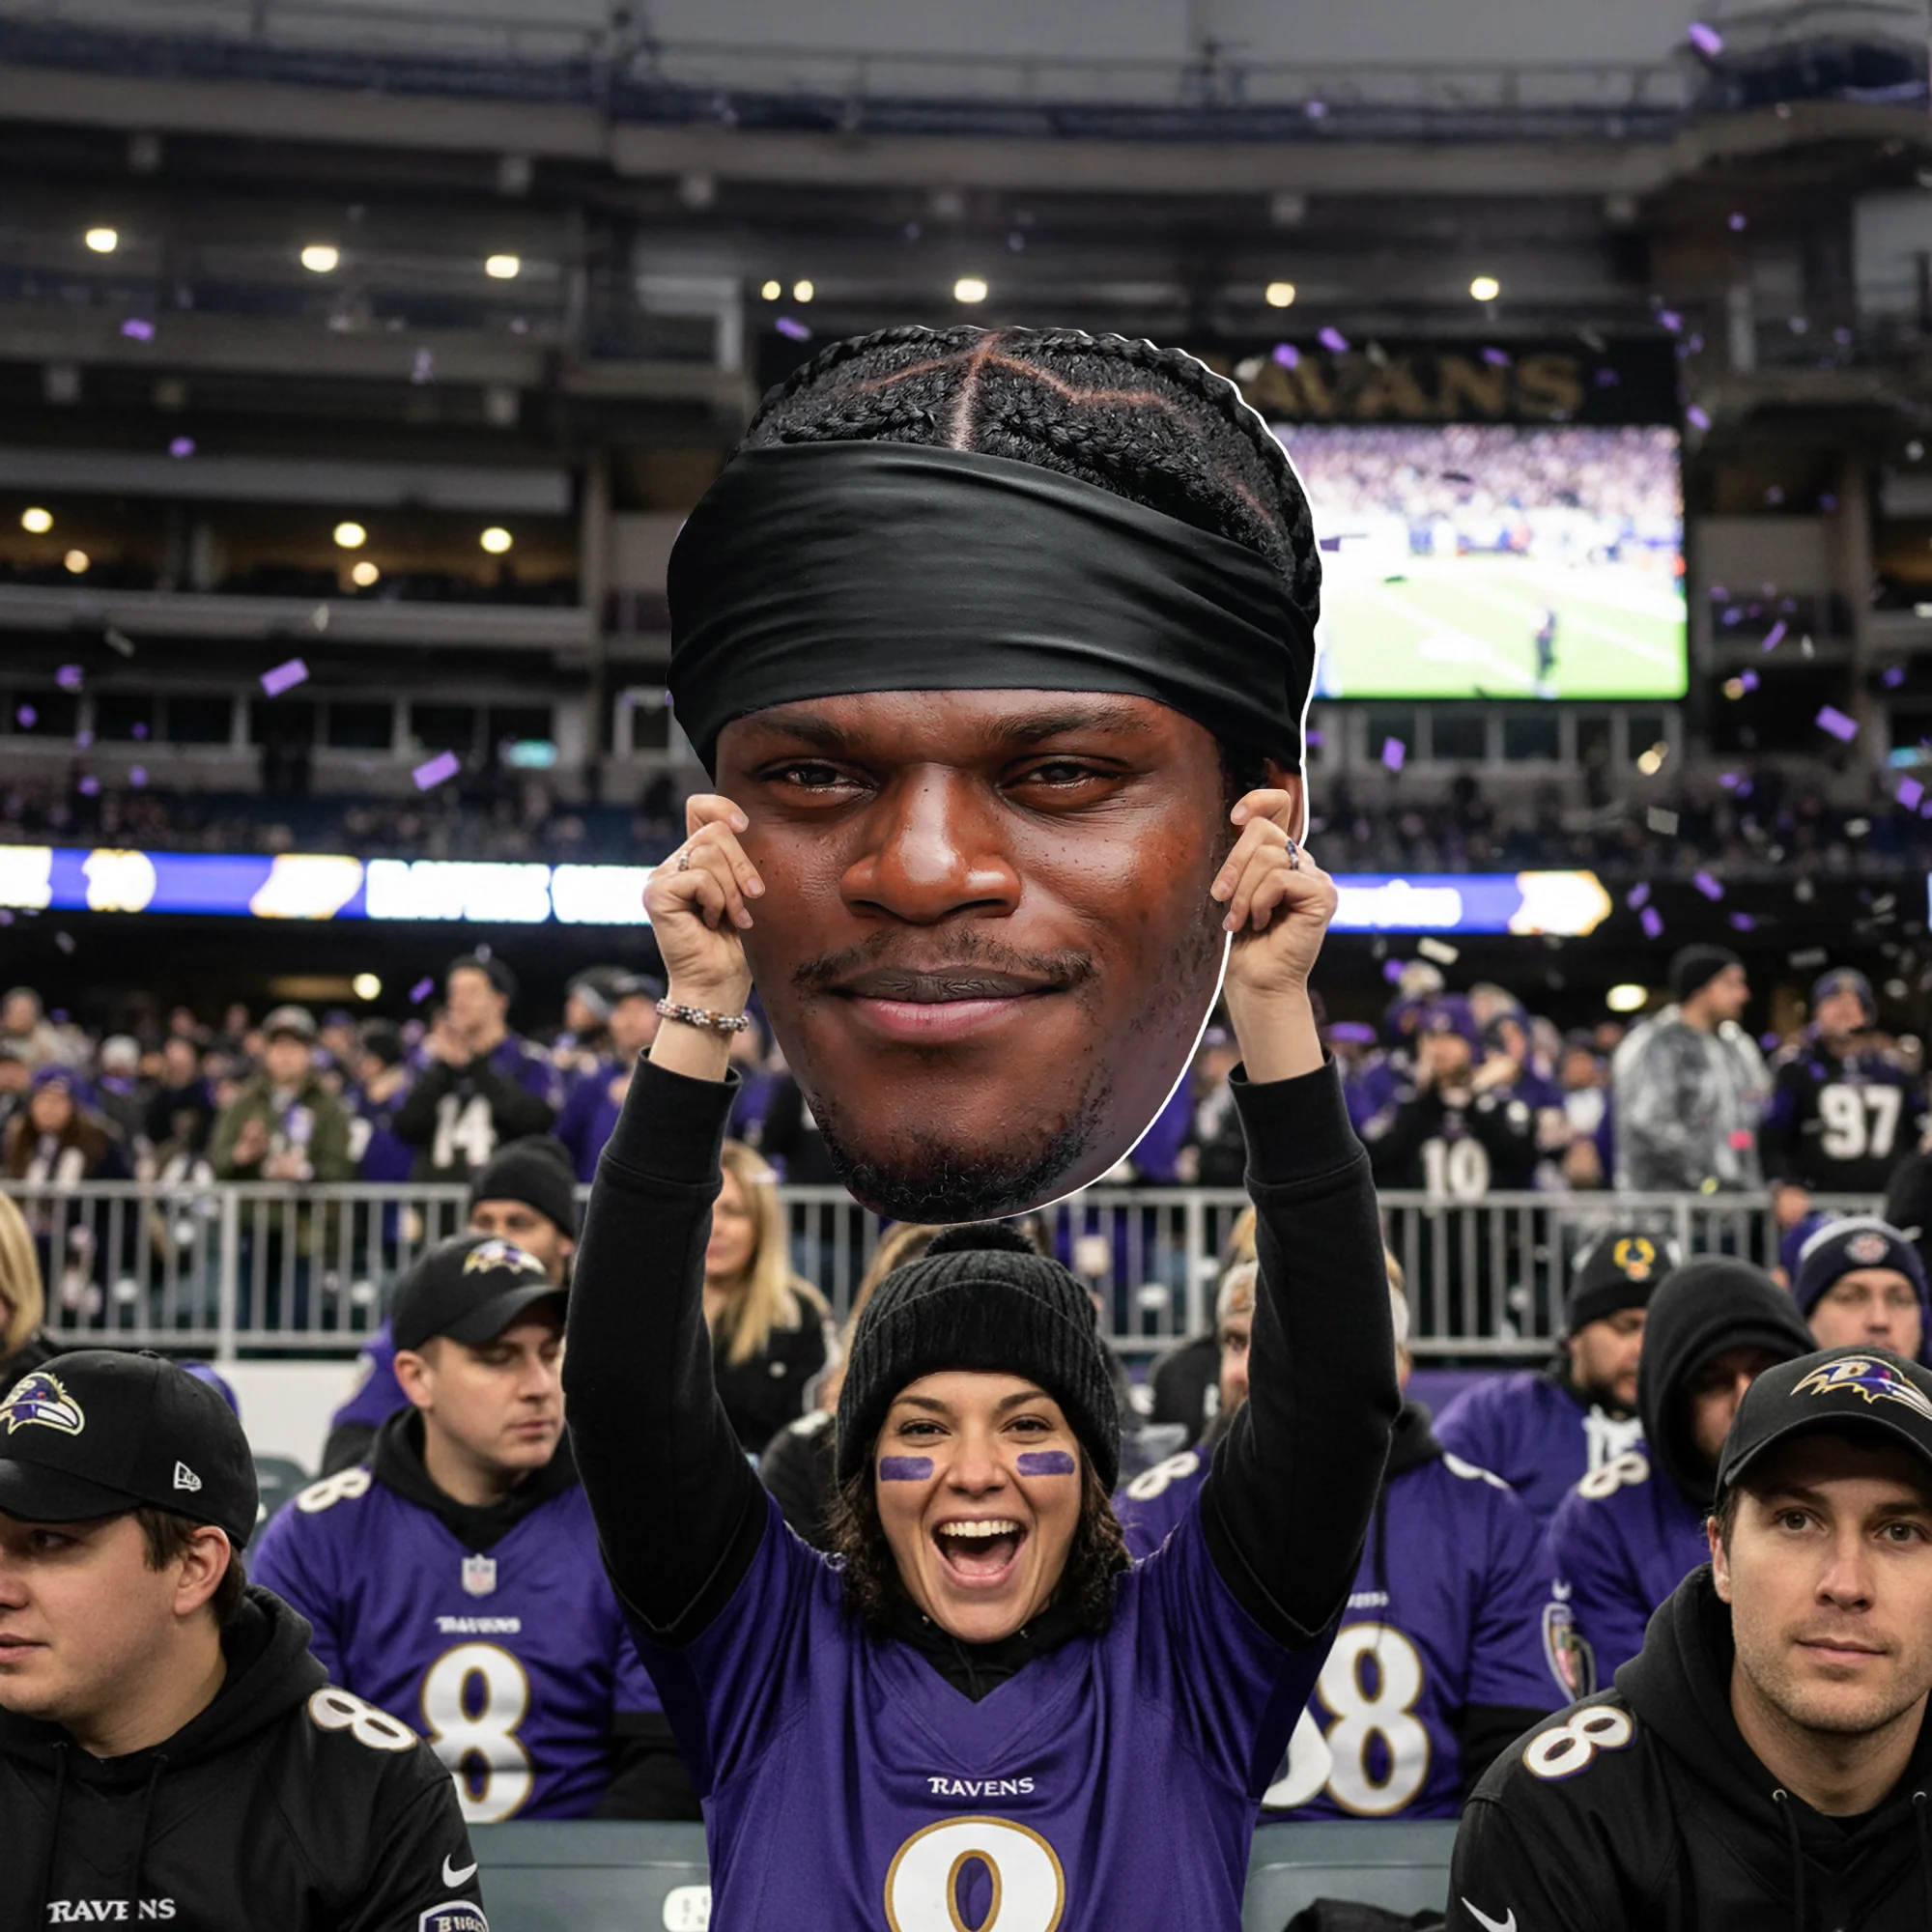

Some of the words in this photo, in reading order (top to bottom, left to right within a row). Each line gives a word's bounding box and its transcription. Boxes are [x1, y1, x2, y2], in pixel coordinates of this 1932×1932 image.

[1186, 352, 1584, 417] AVANS
[434, 1093, 497, 1168] 14
[1818, 1083, 1902, 1159] 97
[1421, 1136, 1490, 1209] 10
[297, 1466, 372, 1513] 8
[1126, 1450, 1200, 1501] 8
[308, 1688, 418, 1751] 8
[422, 1641, 534, 1824] 8
[1522, 1705, 1635, 1781] 8
[927, 1776, 1035, 1797] RAVENS
